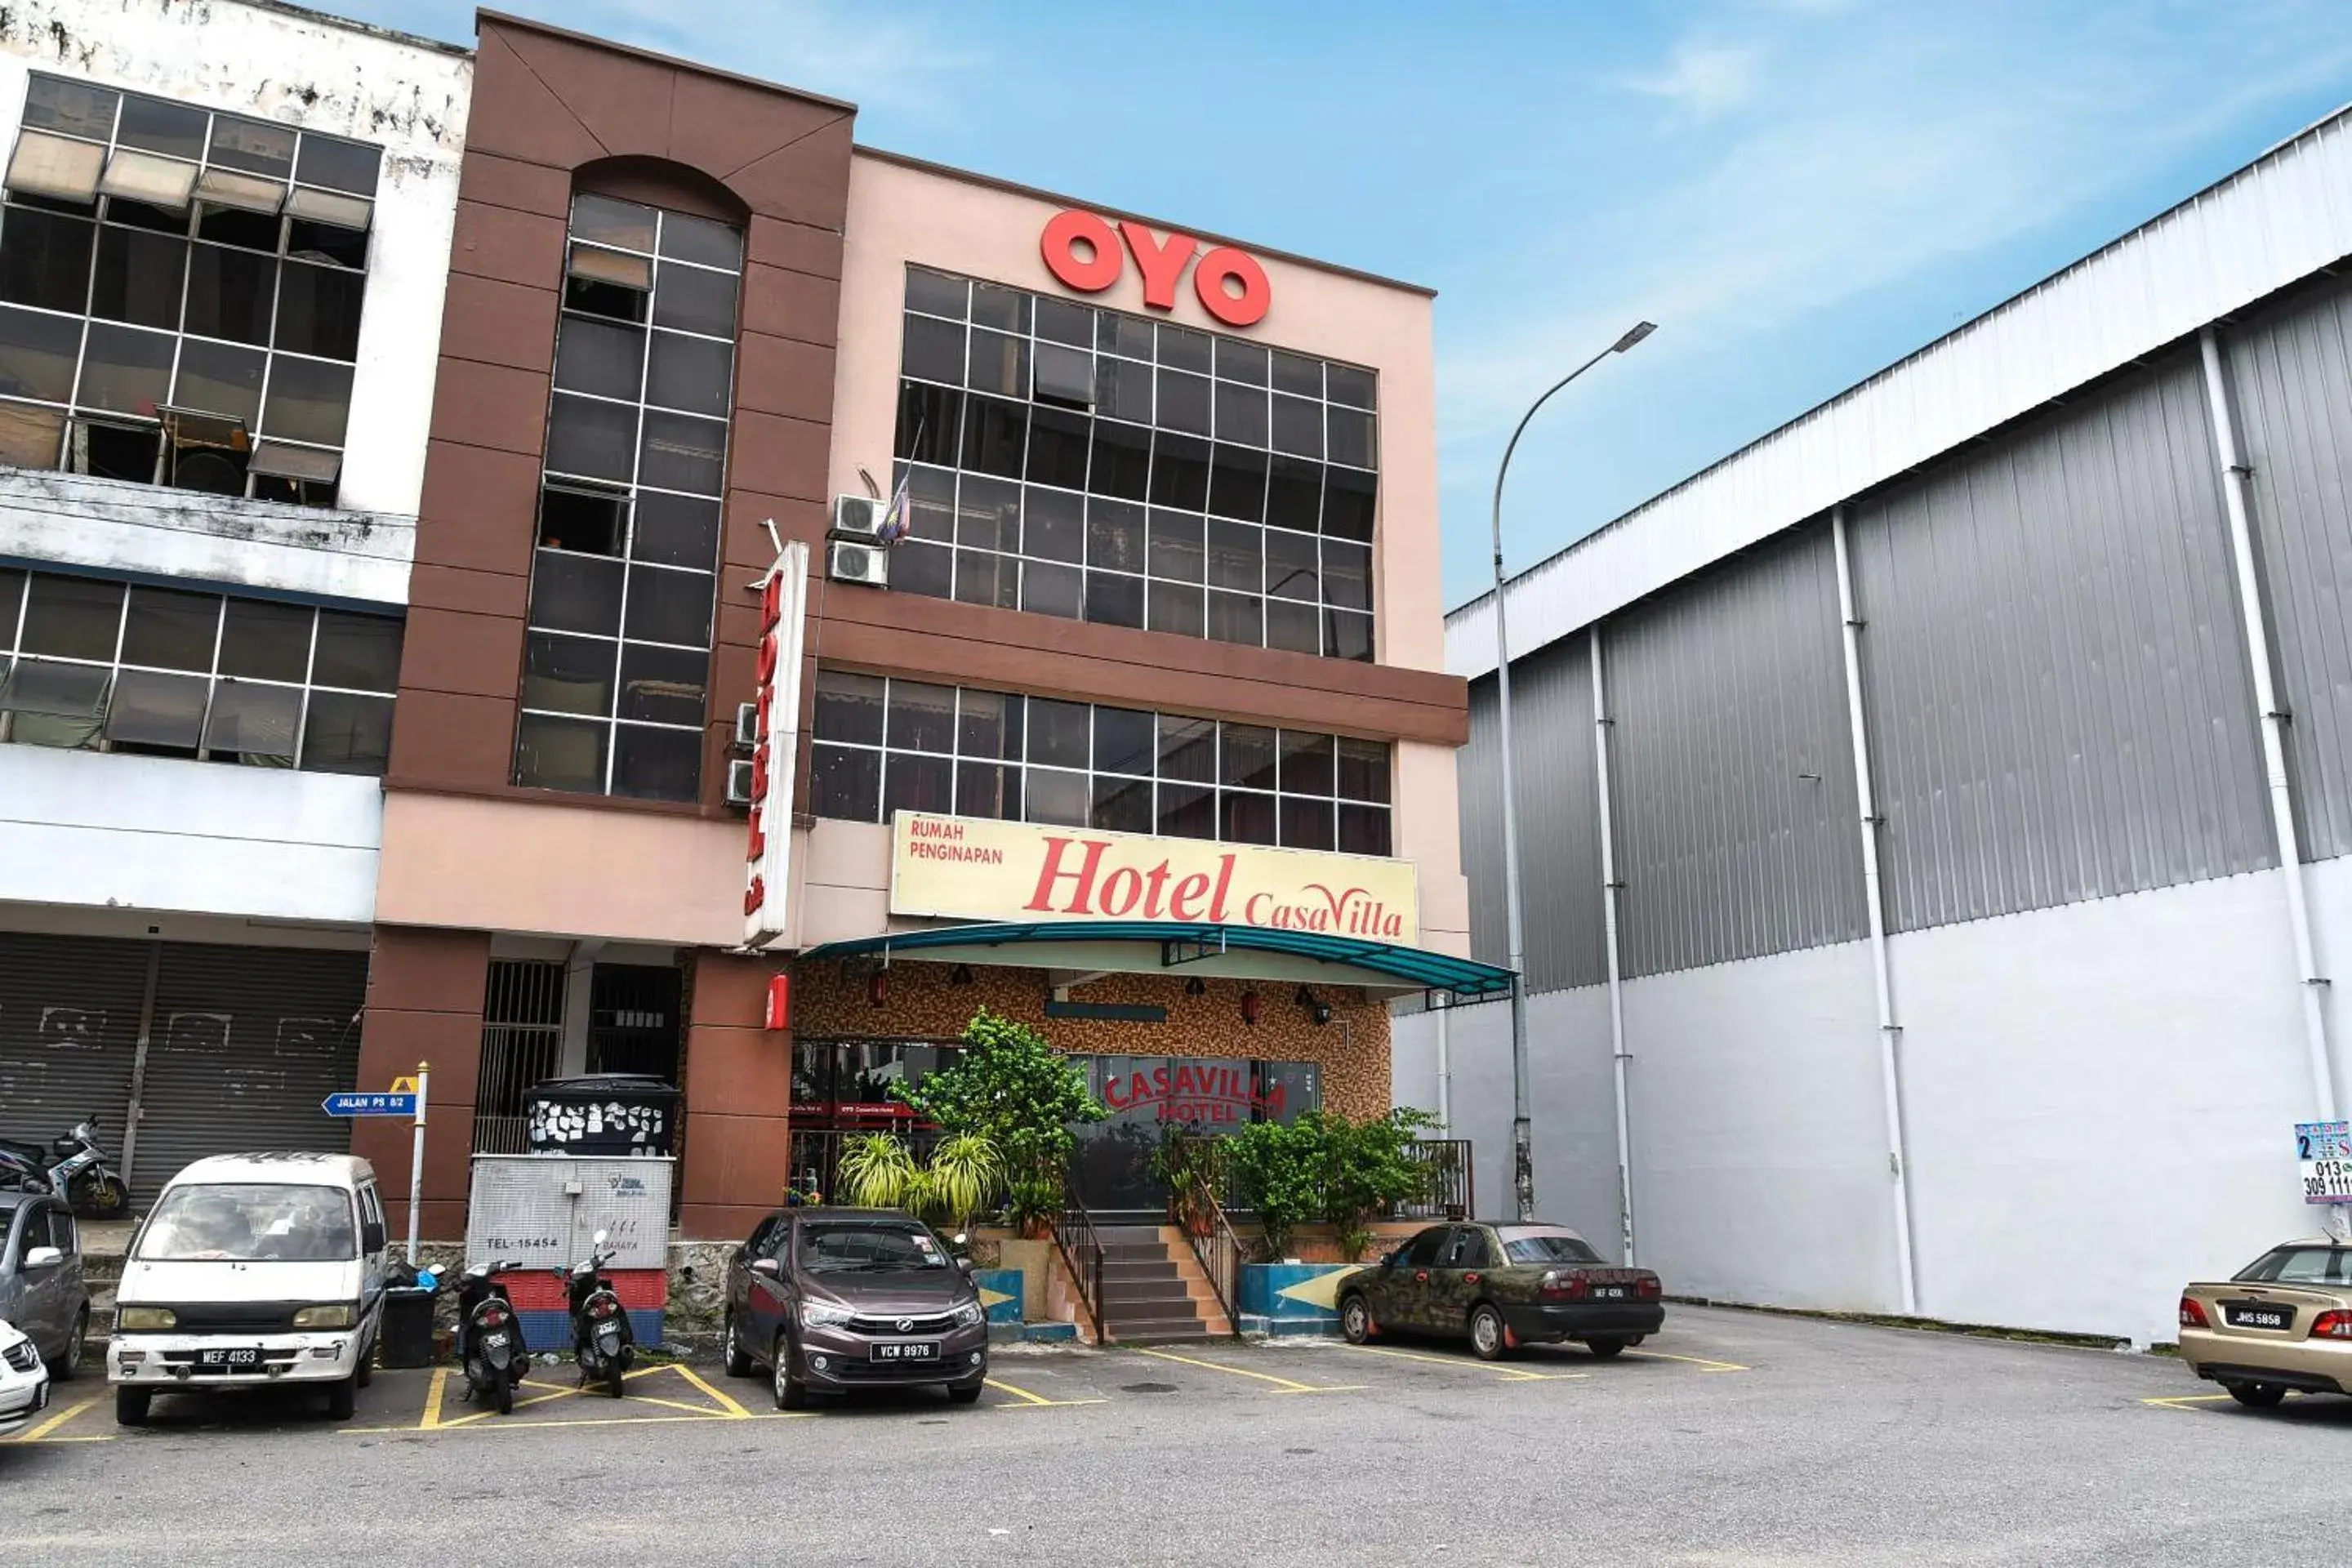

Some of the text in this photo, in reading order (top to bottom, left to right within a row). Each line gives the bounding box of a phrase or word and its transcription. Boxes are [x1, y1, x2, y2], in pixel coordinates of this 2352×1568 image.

[1040, 209, 1271, 327] OYO
[746, 569, 782, 862] HOTEL
[911, 820, 964, 840] RUMAH
[911, 842, 1003, 865] PENGINAPAN
[1022, 837, 1403, 937] Hotel CasaVilla
[1105, 1065, 1286, 1117] CASAVILLA
[336, 1098, 368, 1107] JALAN
[372, 1098, 385, 1107] PS
[1158, 1102, 1237, 1123] HOTEL
[2298, 1136, 2312, 1159] 2
[2315, 1161, 2341, 1177] 013
[2304, 1176, 2352, 1196] 309 111
[2256, 1313, 2281, 1325] 5858
[203, 1350, 256, 1363] WEF 4133
[881, 1345, 901, 1357] VCW
